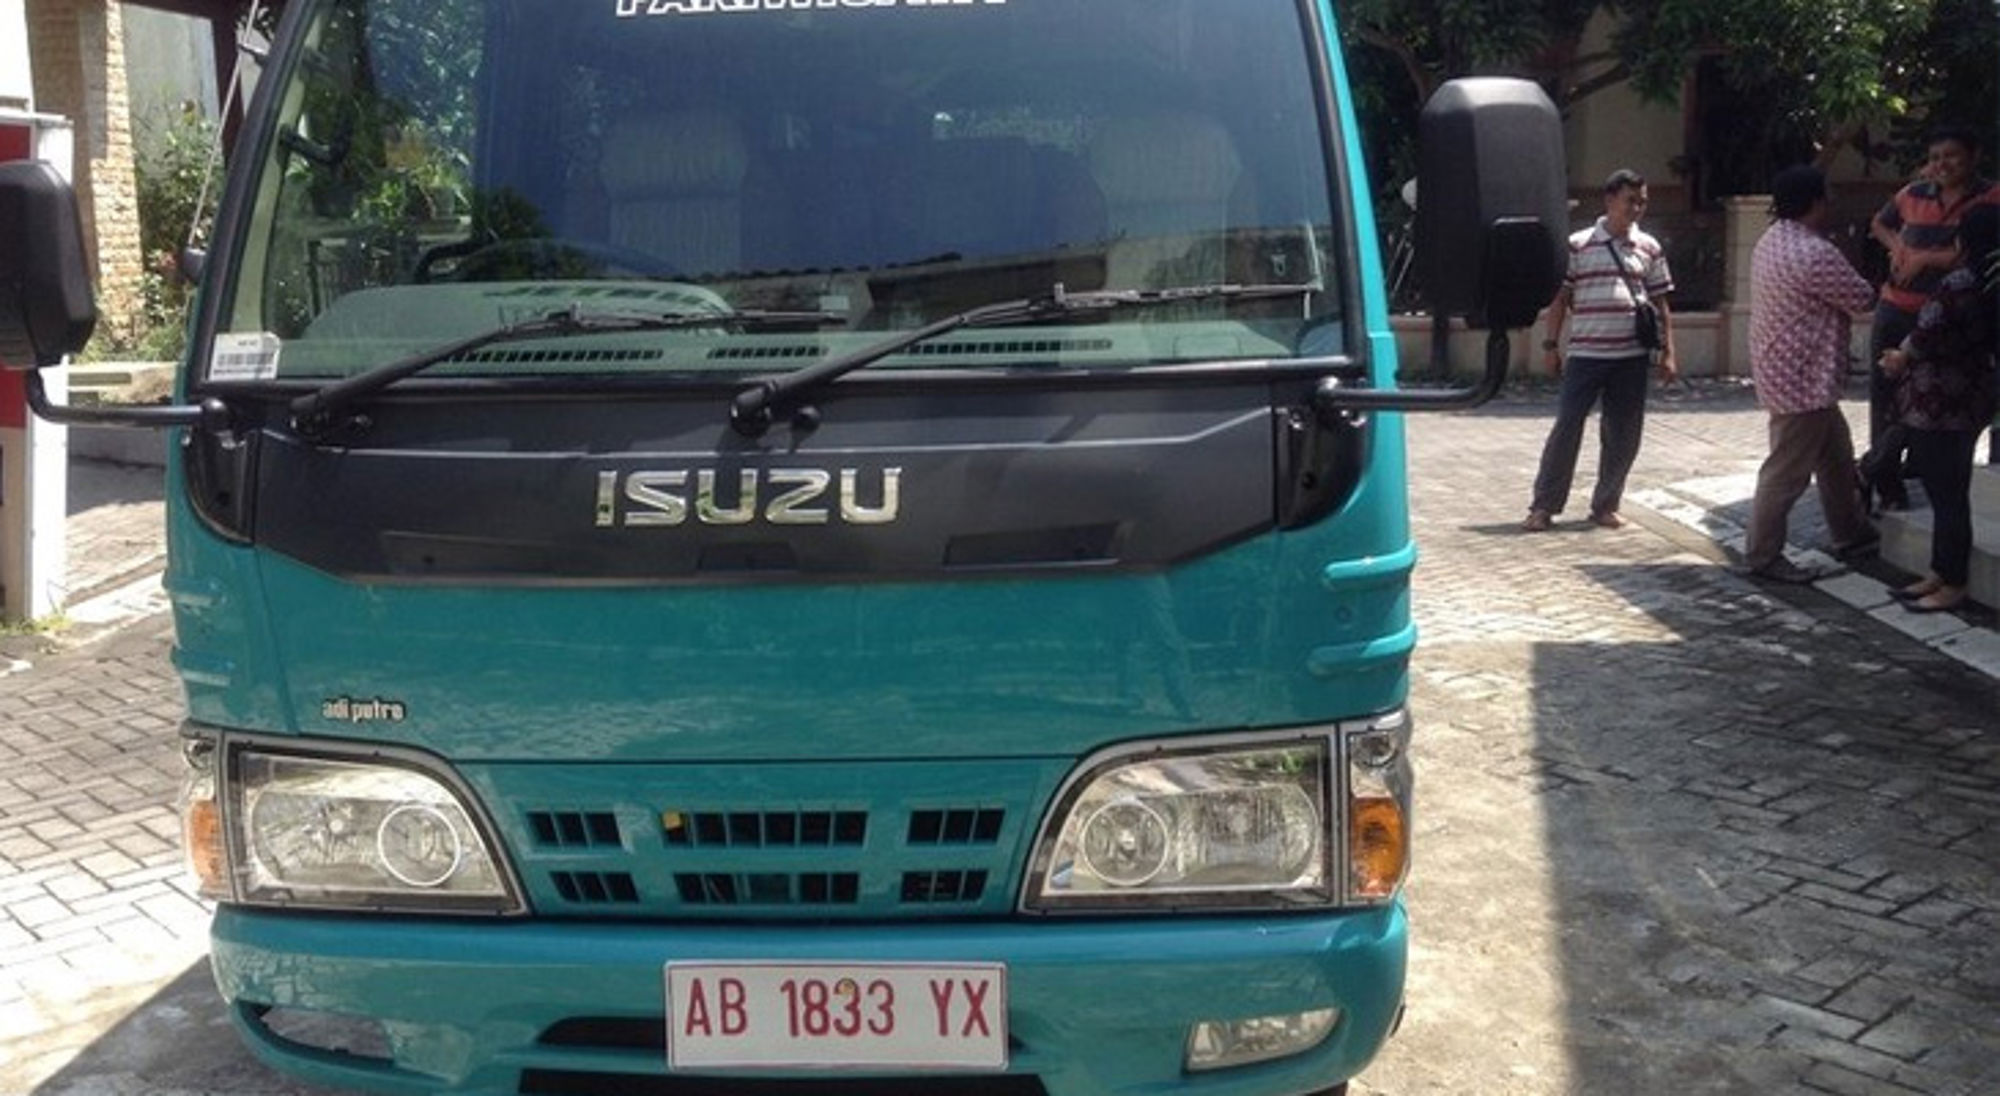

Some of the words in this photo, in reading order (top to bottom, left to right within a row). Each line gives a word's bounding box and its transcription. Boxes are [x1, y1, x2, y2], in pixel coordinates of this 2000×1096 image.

[596, 468, 902, 527] ISUZU
[322, 697, 349, 719] adi
[685, 978, 748, 1036] AB
[779, 978, 895, 1037] 1833
[929, 979, 991, 1037] YX
